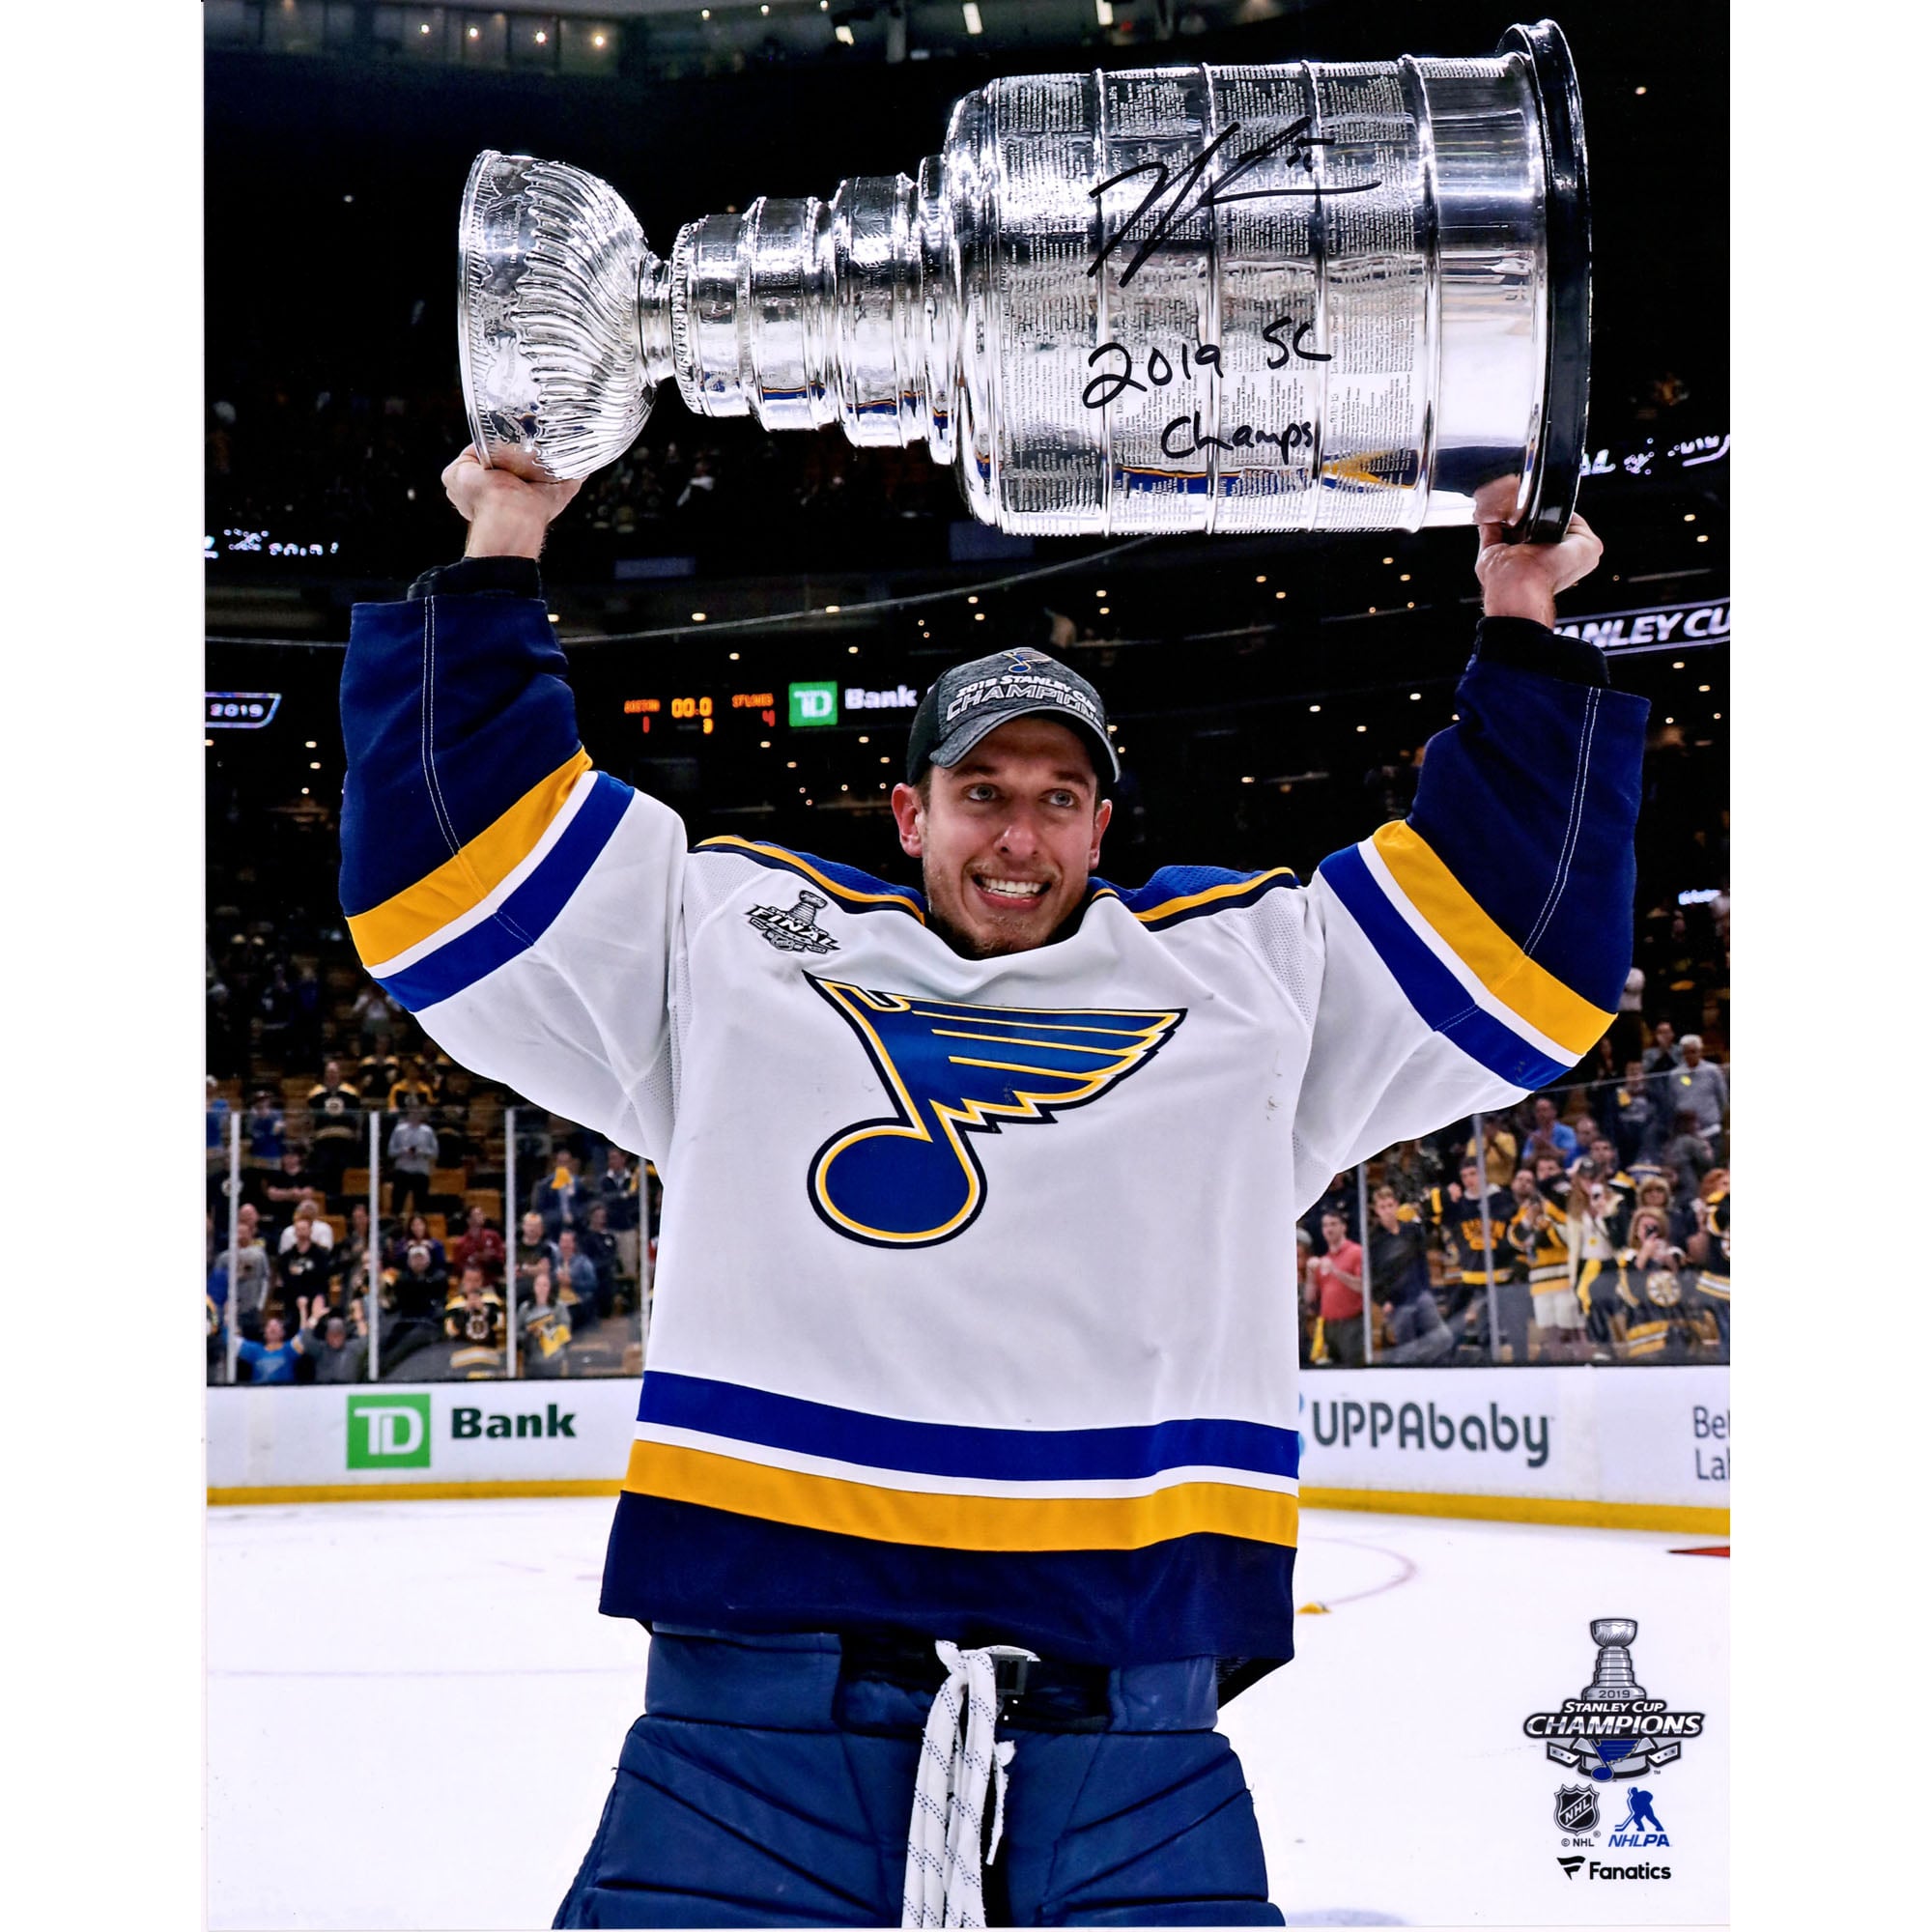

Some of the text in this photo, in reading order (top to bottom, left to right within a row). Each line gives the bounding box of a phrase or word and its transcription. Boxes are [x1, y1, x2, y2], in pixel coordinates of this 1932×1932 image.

[1082, 316, 1333, 409] 2019 SC
[1161, 411, 1314, 465] Champs
[1554, 612, 1685, 648] ANLEY
[793, 685, 918, 718] TD Bank
[1000, 674, 1072, 693] STANLEY
[210, 703, 264, 717] 2019
[750, 906, 840, 950] FINAL
[354, 1404, 577, 1456] TD Bank
[1312, 1401, 1549, 1468] UPPAbaby
